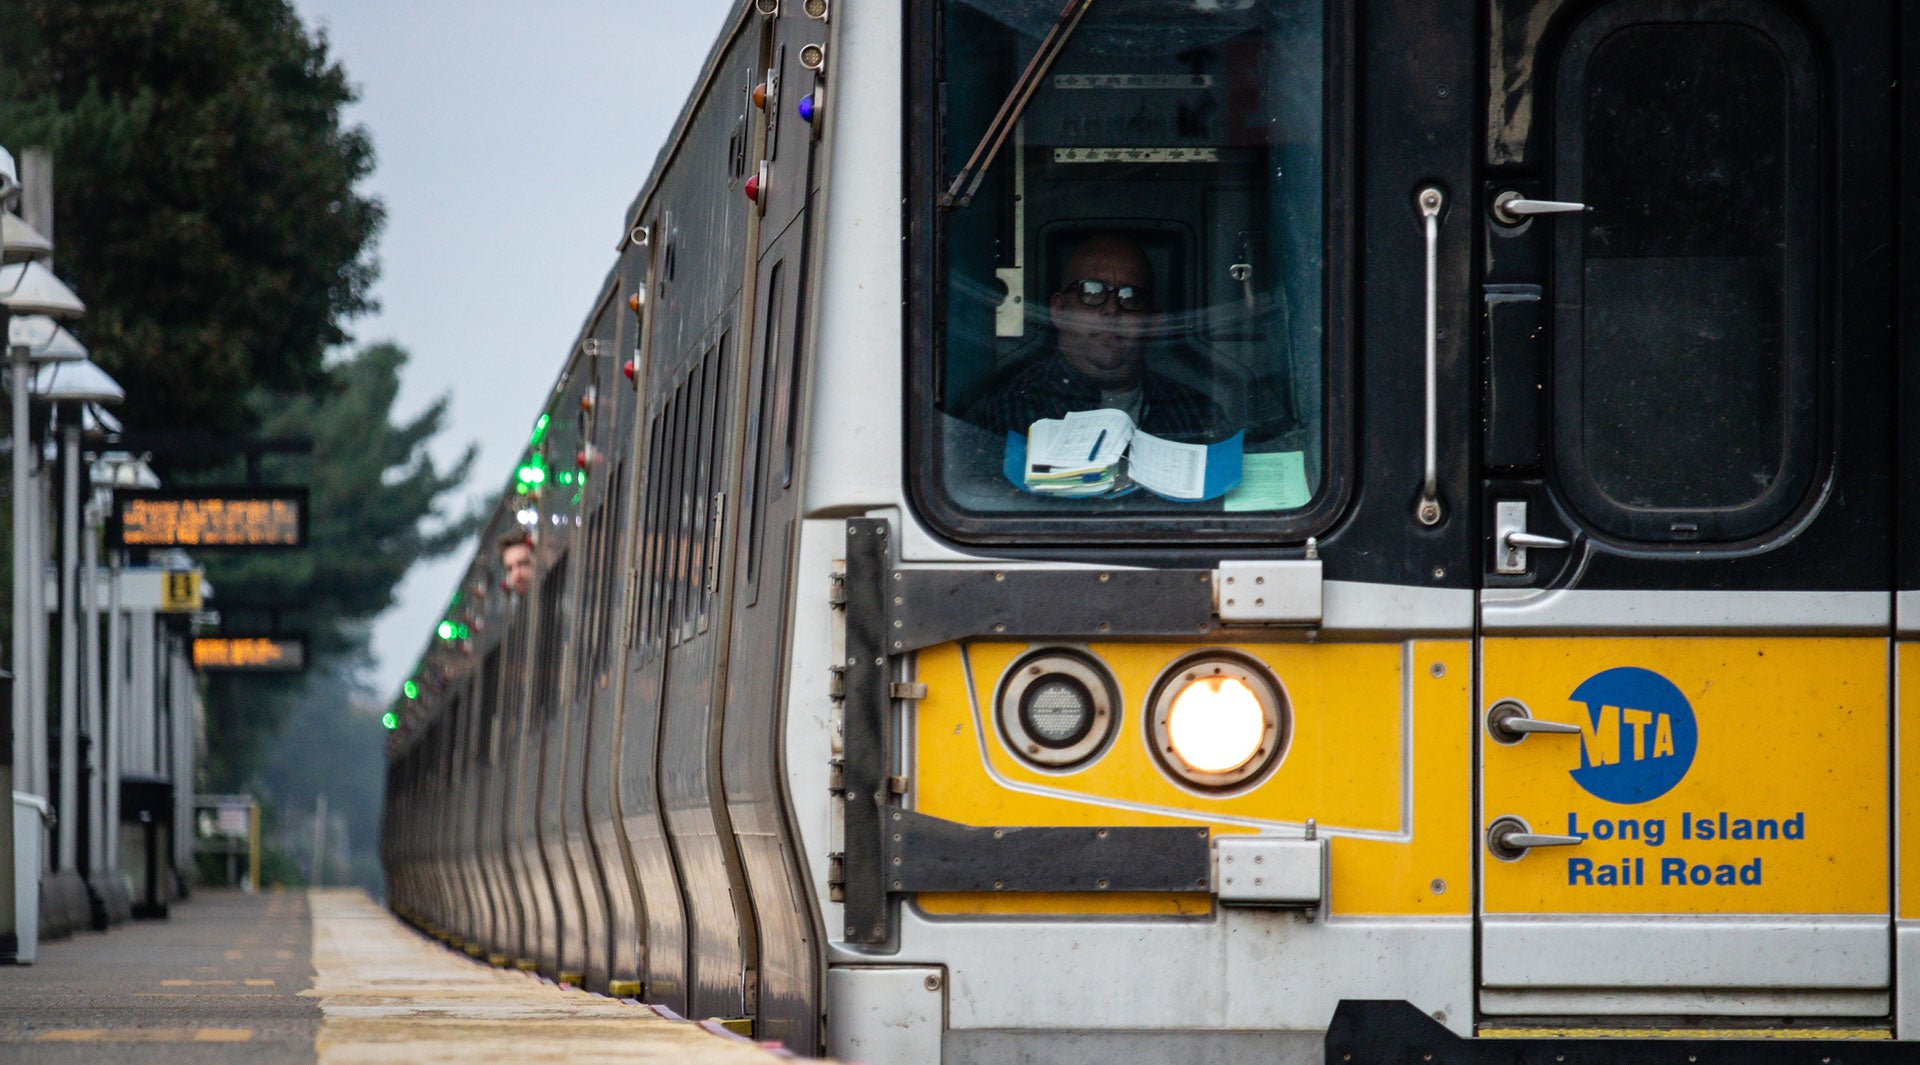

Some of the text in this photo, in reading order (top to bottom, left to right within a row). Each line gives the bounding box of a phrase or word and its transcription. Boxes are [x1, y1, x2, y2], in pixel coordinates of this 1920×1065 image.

[1569, 700, 1675, 771] MTA
[1568, 811, 1805, 846] Long Island
[1568, 857, 1762, 886] Rail Road
